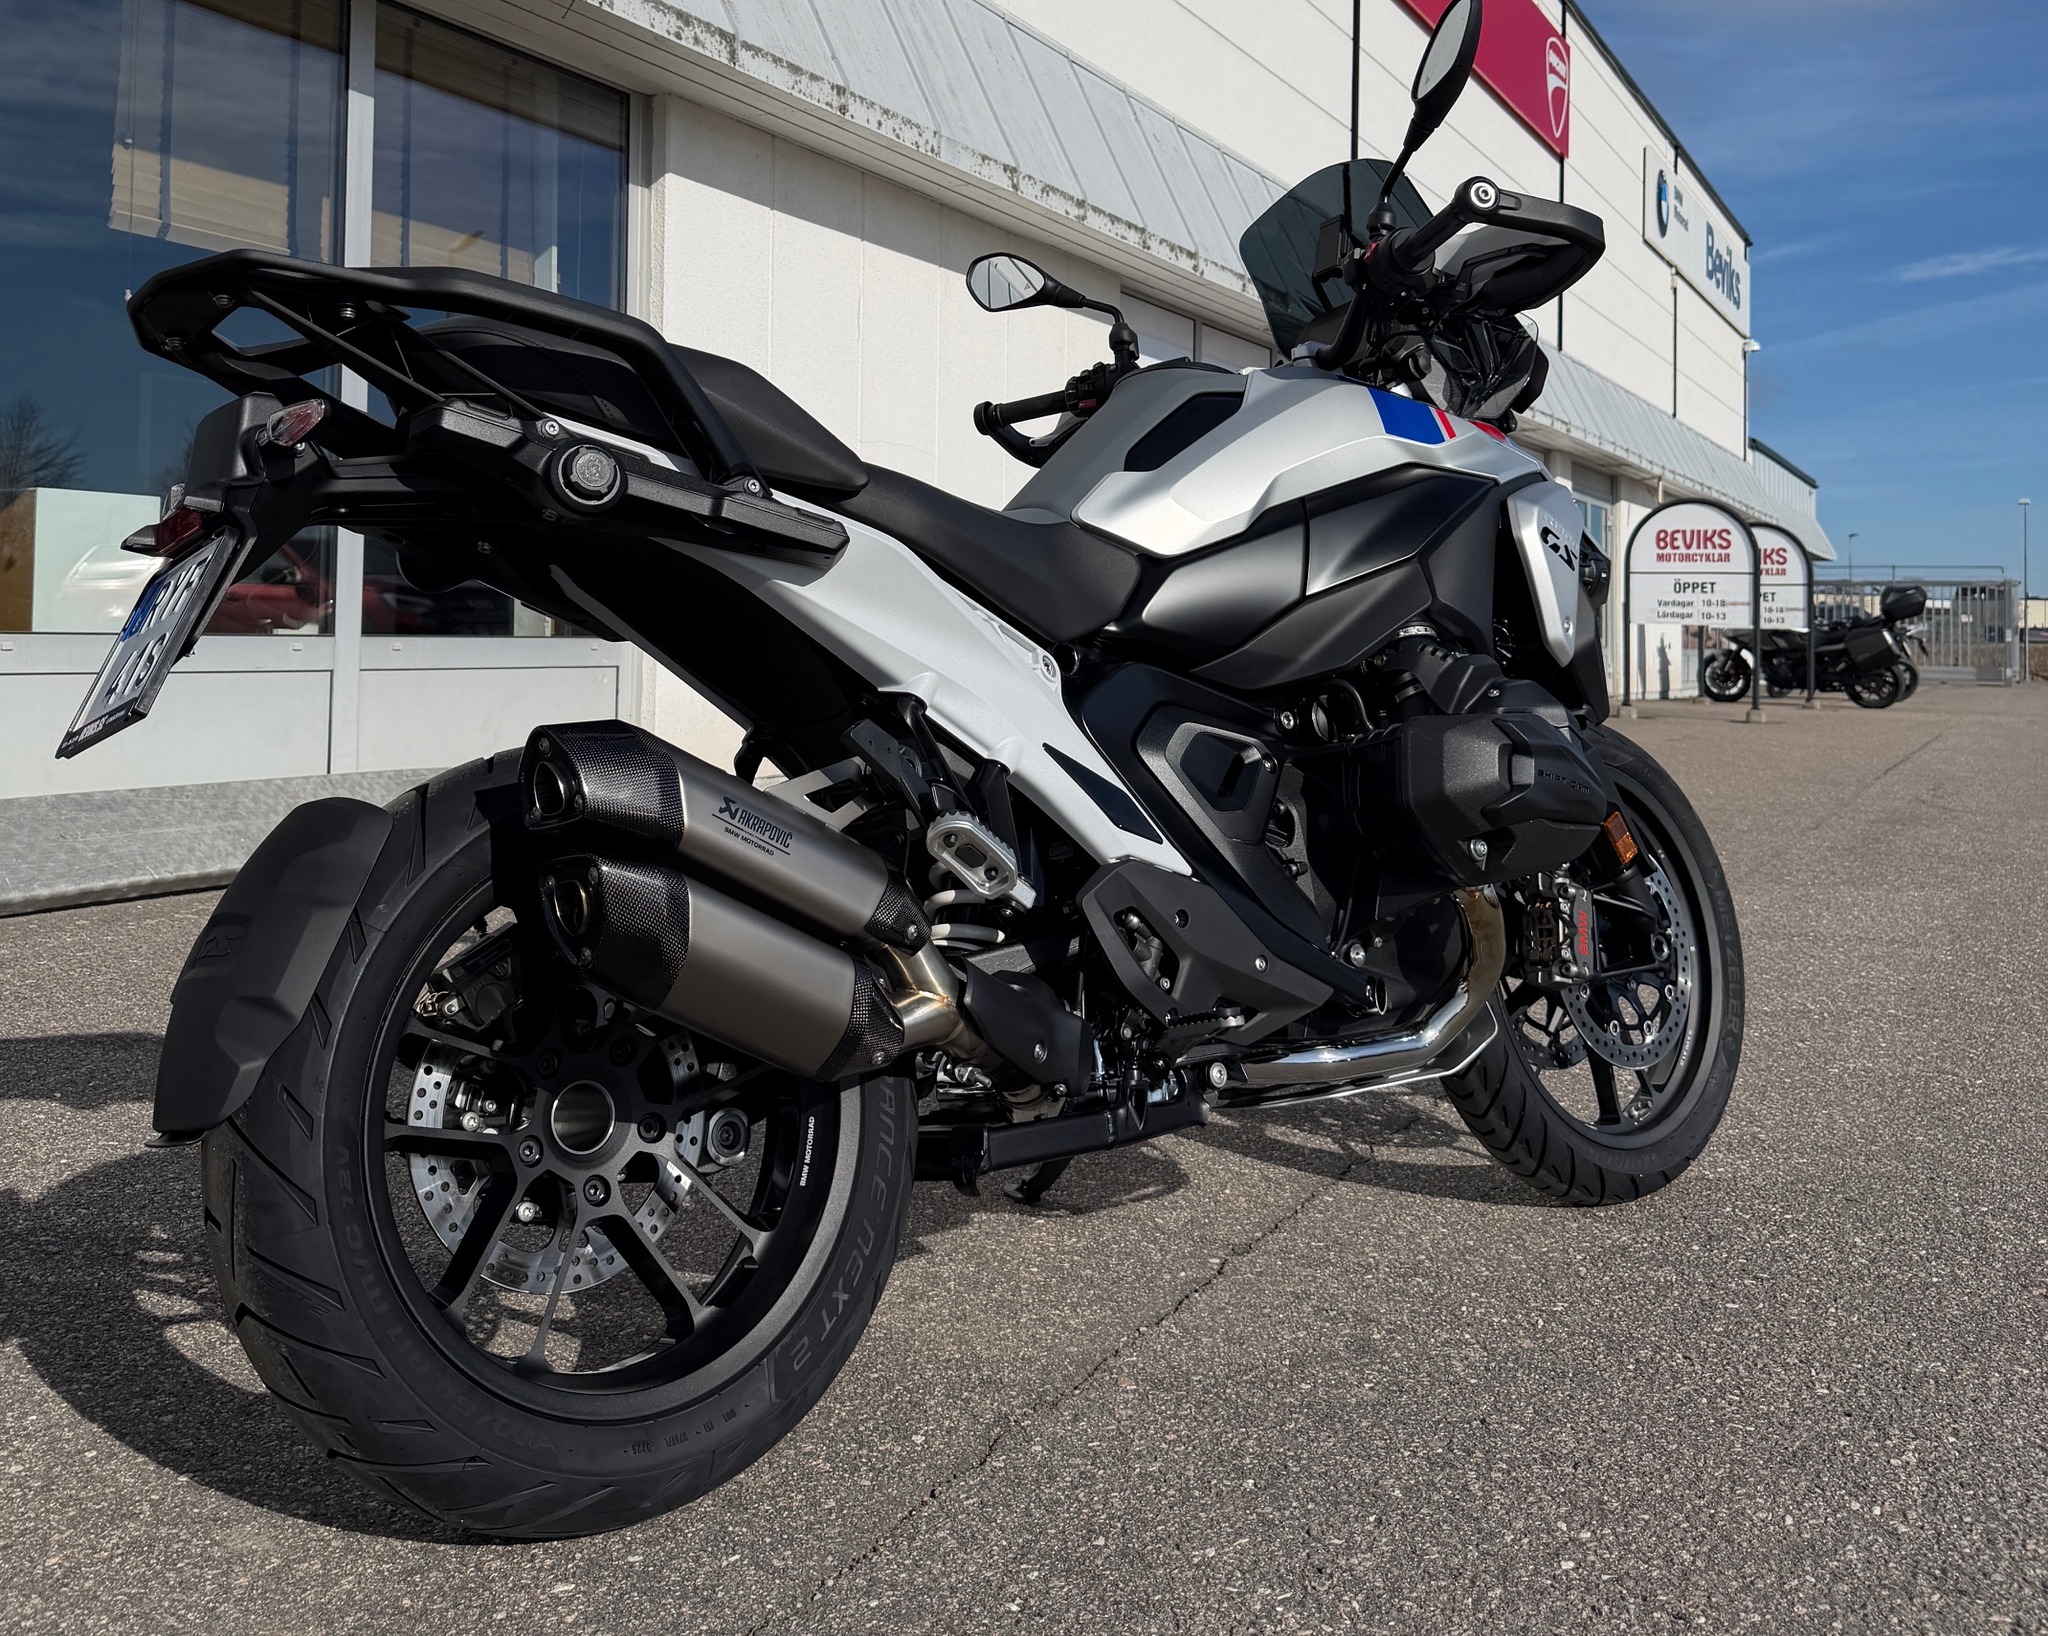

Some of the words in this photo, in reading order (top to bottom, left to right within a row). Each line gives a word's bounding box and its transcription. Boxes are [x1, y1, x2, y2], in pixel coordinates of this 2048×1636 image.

[1705, 220, 1741, 310] Beviks
[1540, 526, 1578, 572] GS
[1655, 528, 1732, 550] BEVIKS
[1656, 552, 1730, 563] MOTORCYKLAR
[1673, 578, 1716, 594] ÖPPET
[1657, 599, 1694, 609] Vardagar
[1701, 599, 1726, 607] 10-18
[1657, 610, 1693, 619] Lördagar
[1701, 612, 1726, 621] 10-13
[724, 826, 741, 839] BMW
[741, 835, 775, 856] MOTORRAD
[1578, 910, 1590, 956] BMW
[799, 1166, 809, 1187] BMW
[804, 1115, 816, 1165] MOTORRAD
[789, 1341, 813, 1373] 2
